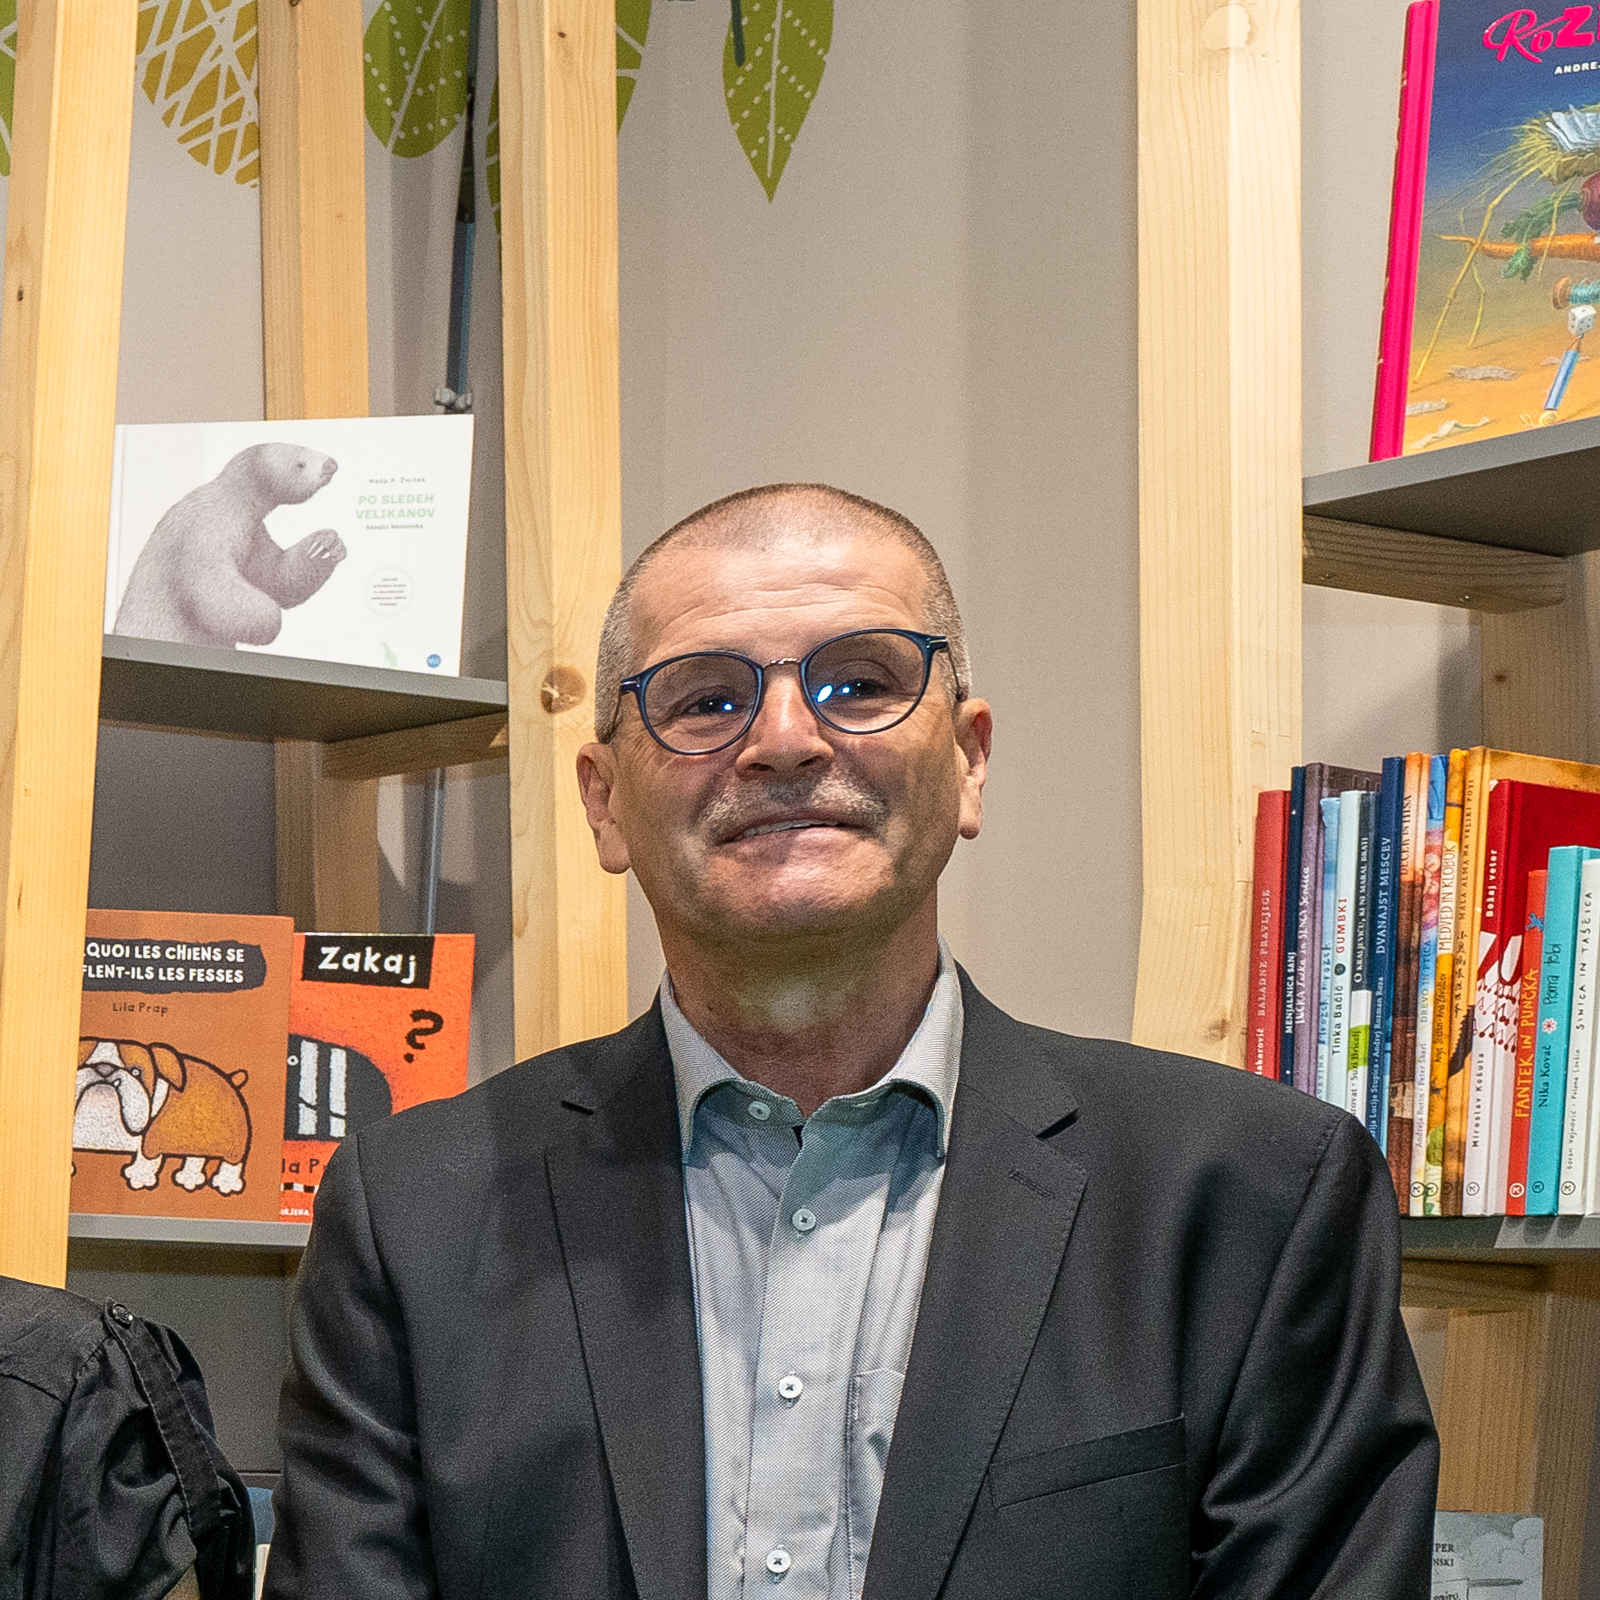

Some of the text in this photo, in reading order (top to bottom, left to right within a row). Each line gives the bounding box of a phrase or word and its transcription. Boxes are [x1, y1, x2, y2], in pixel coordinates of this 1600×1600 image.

[1483, 5, 1600, 63] RoZ
[1554, 62, 1600, 75] ANDRE
[355, 508, 436, 520] VELIKANOV
[358, 494, 434, 506] PO SLEDEH
[1374, 836, 1392, 953] DVANAJST MESCEV
[1438, 845, 1456, 950] MEDVED IN KLOBUK
[81, 964, 243, 984] FLENT-ILS LES FESSES
[82, 943, 245, 964] QUOI LES CHIENS SE
[317, 946, 418, 984] Zakaj
[1253, 889, 1272, 1074] akarovič BALADNE PRAVLJICE
[1575, 891, 1593, 1030] SINICA IN TAŠČICA
[112, 1001, 168, 1017] Lila Prap
[1283, 950, 1297, 1033] MENJALNICA SANJ
[404, 1009, 443, 1064] ?
[1369, 975, 1385, 1117] Lucija Stupica Andrej Rozman Roza
[1513, 967, 1540, 1118] FANTEK IN PUNČKA
[1537, 1043, 1551, 1108] Nika Kovač
